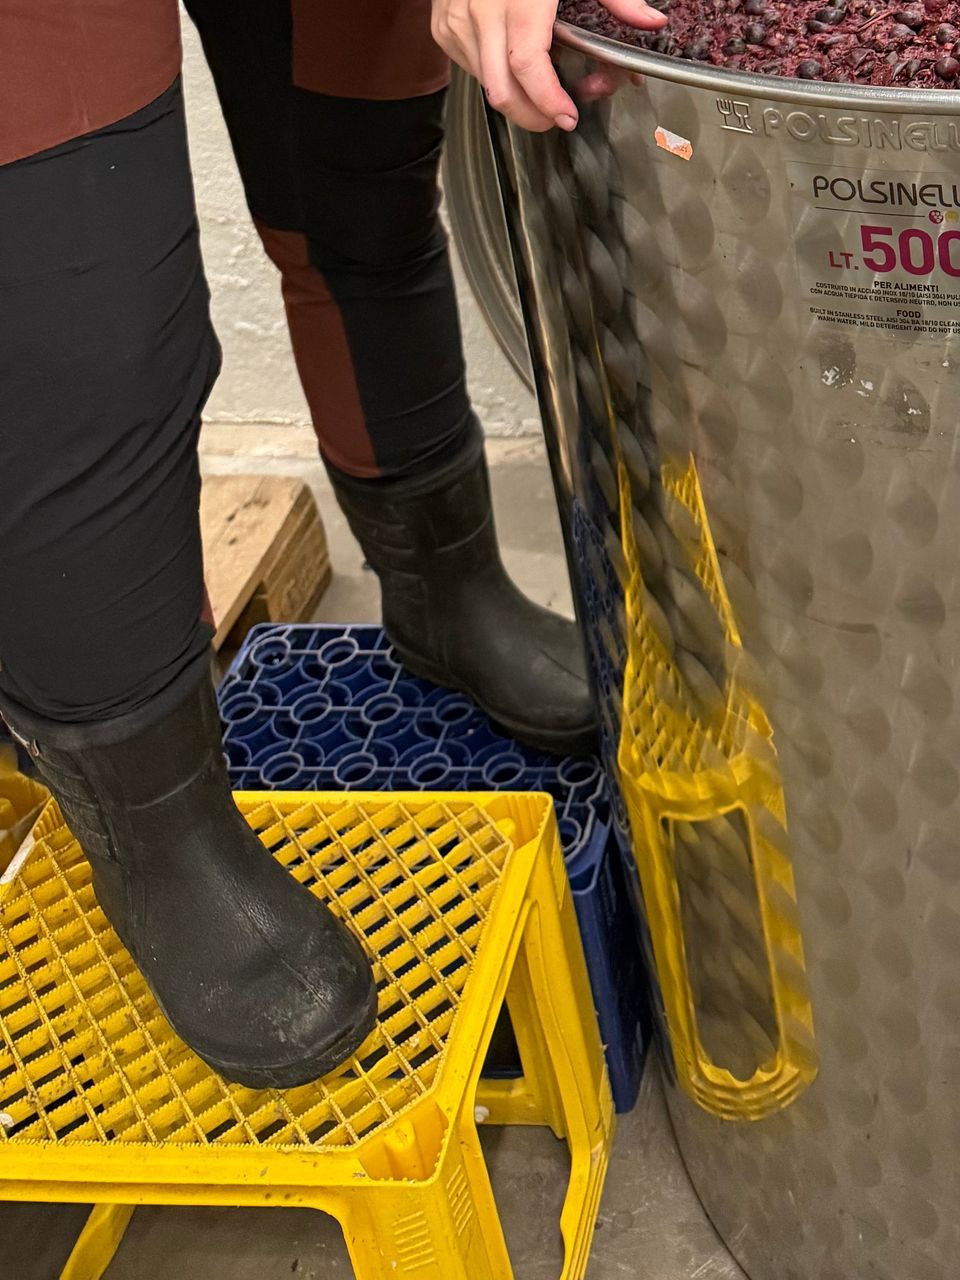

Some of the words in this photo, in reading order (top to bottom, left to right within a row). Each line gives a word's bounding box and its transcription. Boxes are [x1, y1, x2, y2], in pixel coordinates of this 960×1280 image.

[828, 251, 860, 270] LT.
[815, 282, 848, 291] COSTRUITO
[873, 280, 892, 290] PER
[894, 282, 939, 293] ALIMENTI
[809, 287, 823, 295] CON
[823, 289, 844, 298] ACQUA
[844, 292, 868, 301] TIEPIDA
[874, 295, 908, 304] DETERSIVO
[809, 306, 826, 315] BUILT
[865, 314, 885, 322] STEEL
[896, 309, 921, 319] FOOD
[816, 314, 836, 323] WARM
[837, 317, 859, 327] WATER,
[859, 320, 875, 328] MILD
[875, 322, 912, 331] DETERGENT
